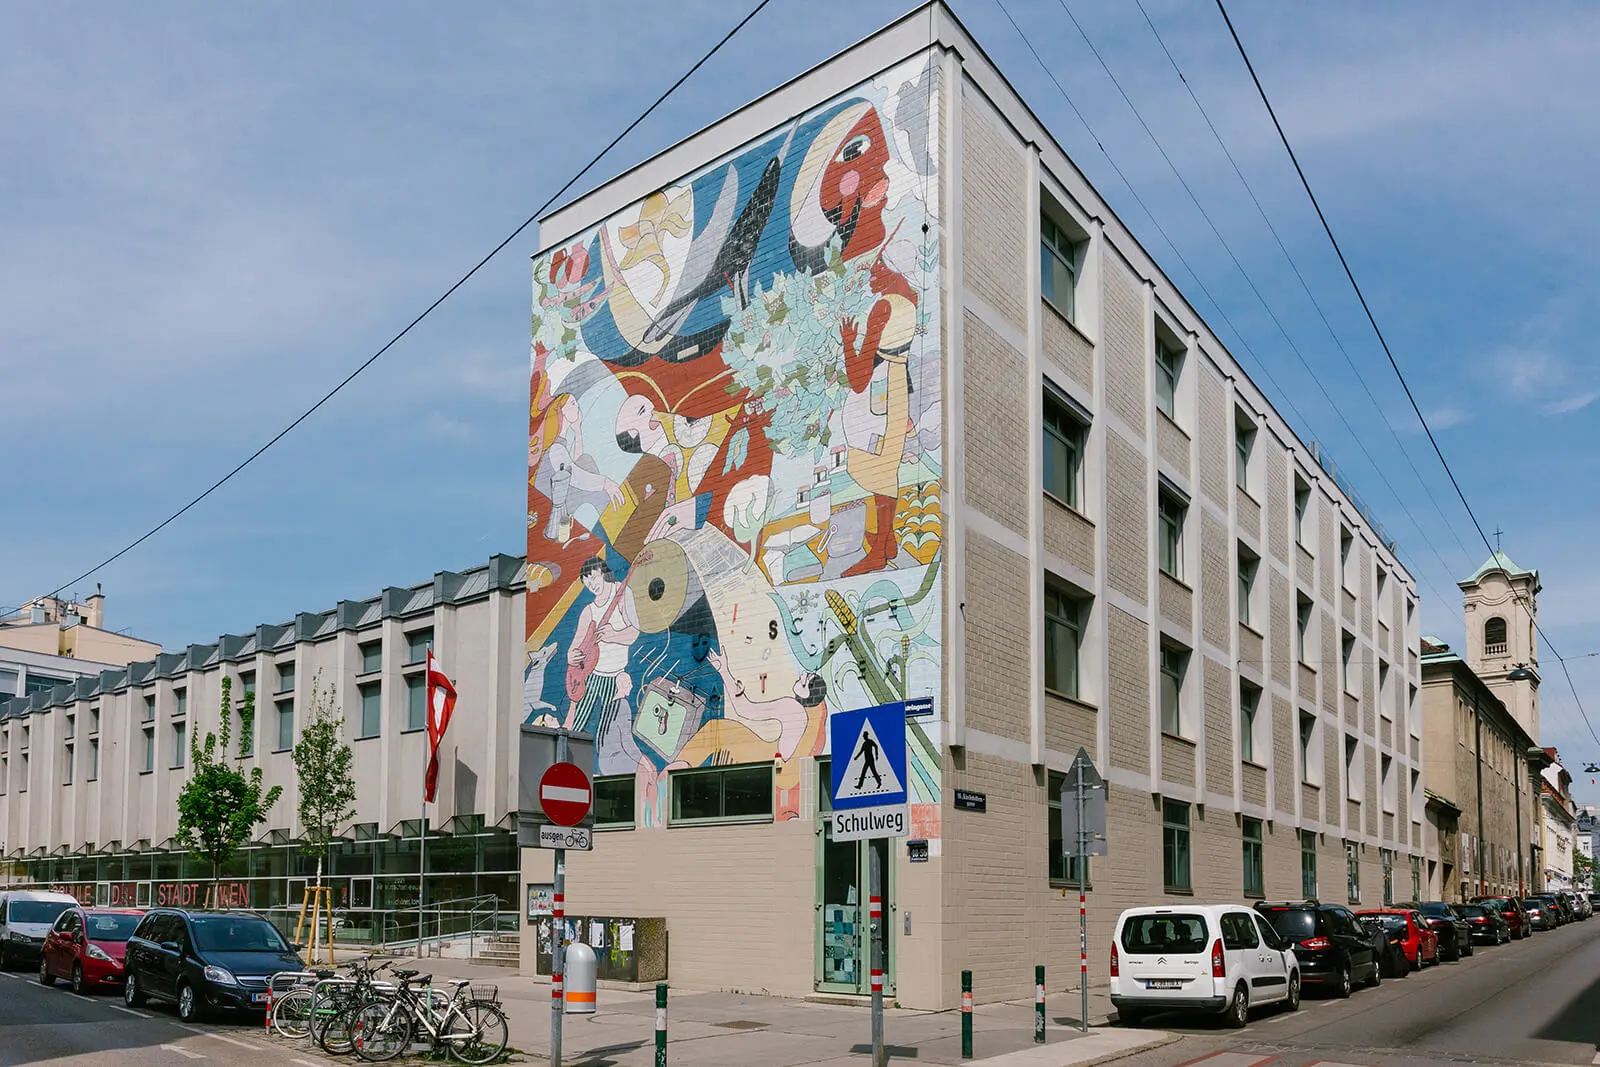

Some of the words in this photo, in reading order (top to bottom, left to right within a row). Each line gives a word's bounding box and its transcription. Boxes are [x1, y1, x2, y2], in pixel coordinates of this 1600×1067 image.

[836, 811, 904, 834] Schulweg
[112, 885, 135, 905] DER
[158, 883, 199, 906] STADT
